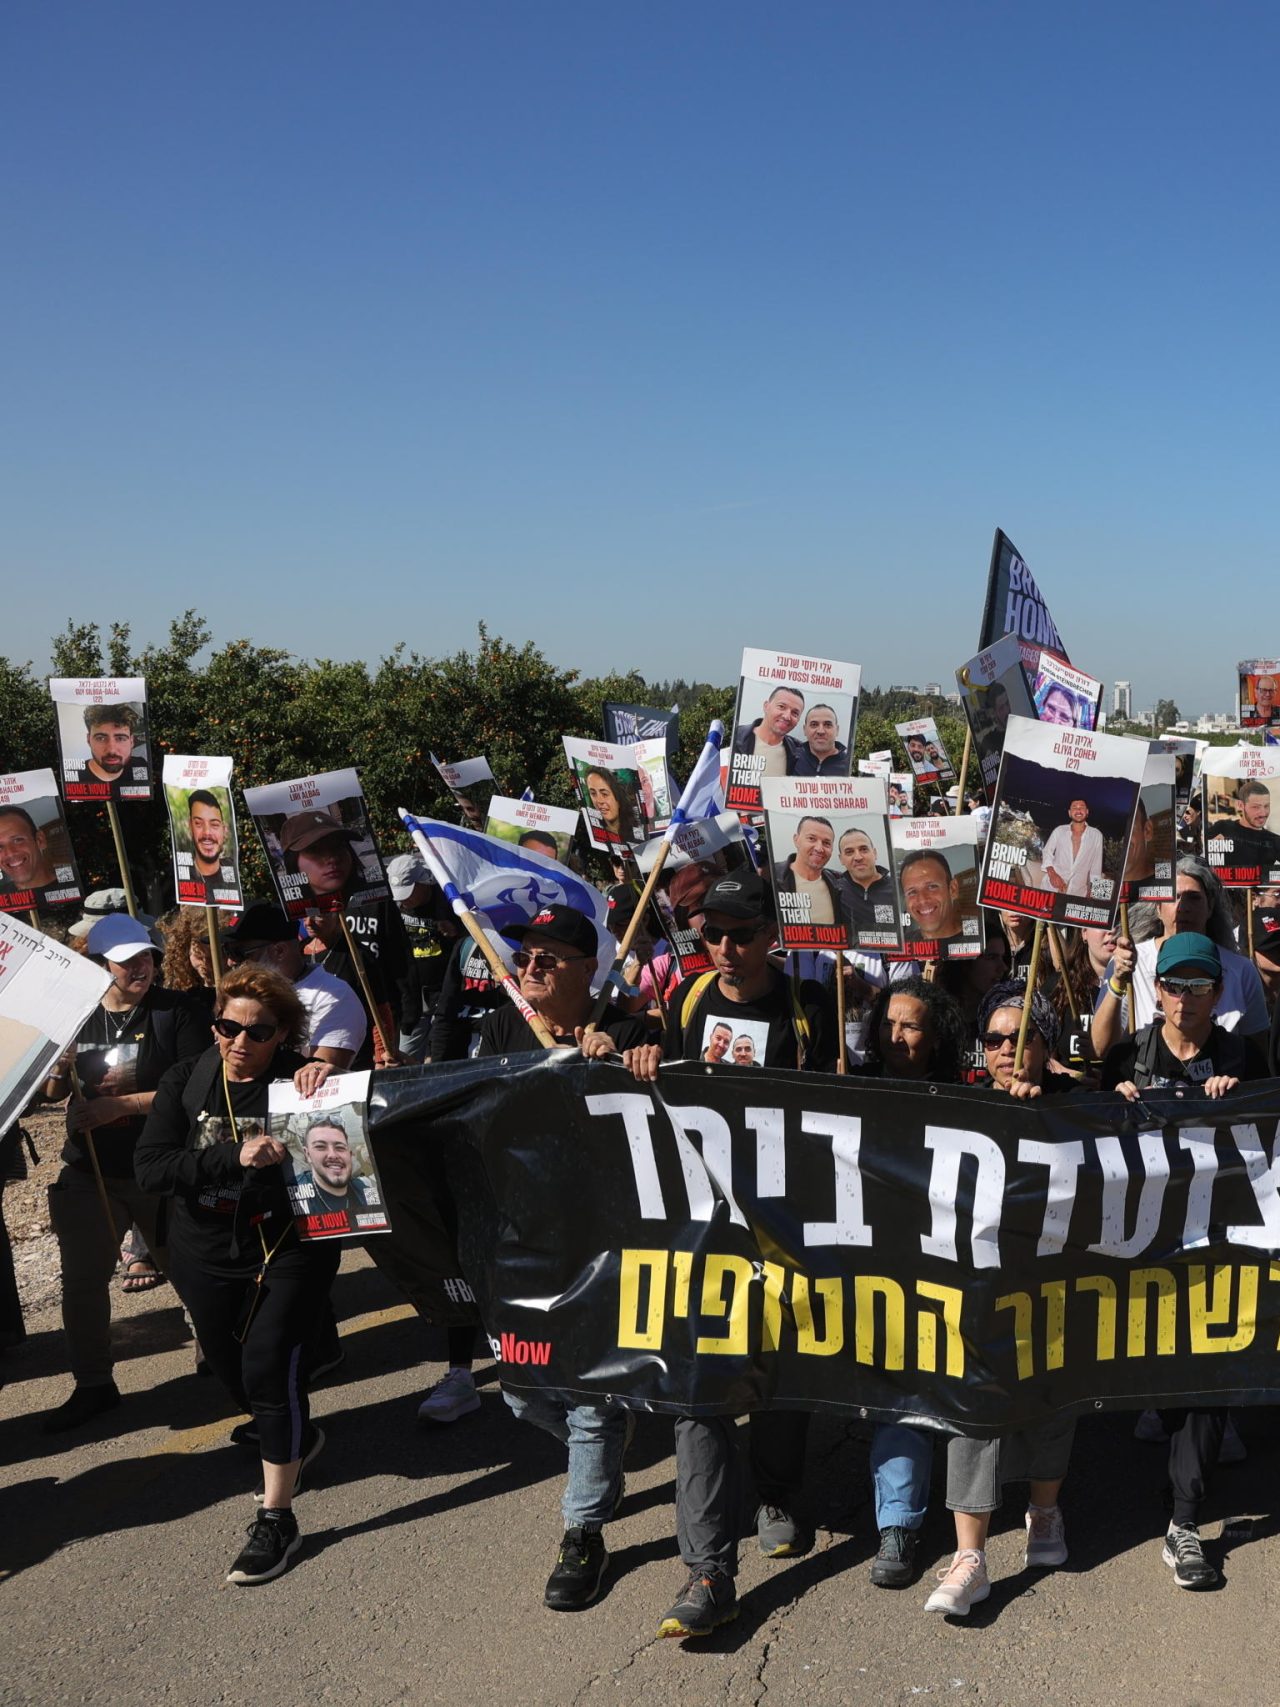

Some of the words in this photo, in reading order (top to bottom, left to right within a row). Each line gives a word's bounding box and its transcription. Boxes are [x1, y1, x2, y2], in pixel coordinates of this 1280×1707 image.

[777, 656, 800, 668] שרעבי
[1019, 646, 1040, 663] TAGES
[802, 660, 818, 671] ויוסי
[820, 662, 832, 673] אלי
[759, 667, 769, 677] ELI
[771, 669, 786, 680] AND
[788, 671, 808, 683] YOSSI
[811, 674, 843, 689] SHARABI
[1056, 674, 1093, 697] STEINBRECHER
[1062, 733, 1074, 744] כהן
[1075, 734, 1093, 746] אליה
[1054, 744, 1072, 757] ELIYA
[1074, 747, 1097, 761] COHEN
[64, 759, 85, 770] BRING
[733, 753, 766, 771] BRING
[1065, 759, 1080, 770] (27)
[65, 770, 79, 782] HIM
[732, 769, 760, 786] THEM
[66, 784, 88, 795] HOME
[89, 783, 111, 795] NOW!
[290, 792, 301, 801] LIRI
[301, 789, 320, 799] ALBAG
[795, 782, 819, 794] שרעבי
[820, 782, 836, 794] ויוסי
[837, 782, 853, 793] אלי
[729, 787, 760, 804] HOME
[781, 797, 792, 808] ELI
[793, 797, 808, 809] AND
[809, 798, 832, 809] YOSSI
[833, 798, 868, 809] SHARABI
[529, 812, 550, 822] WENKERT
[1208, 840, 1234, 852] BRING
[177, 851, 193, 866] BRING
[991, 842, 1028, 866] BRING
[1209, 853, 1224, 866] HIM
[178, 866, 190, 880] HIM
[988, 860, 1011, 881] HIM
[1234, 866, 1261, 881] NOW!
[278, 872, 308, 889] BRING
[283, 888, 303, 901] HER
[779, 891, 811, 908] BRING
[985, 880, 1018, 901] HOME
[1021, 889, 1056, 912] NOW!
[780, 908, 811, 924] THEM
[345, 915, 378, 935] OUR
[672, 928, 700, 943] BRING
[784, 926, 814, 942] HOME
[817, 926, 847, 942] NOW!
[859, 936, 879, 945] FAMILIES
[676, 941, 696, 954] HER
[913, 940, 939, 955] NOW!
[45, 949, 71, 969] חייב
[682, 954, 707, 971] HOME
[585, 1092, 873, 1248] ביחד
[288, 1183, 315, 1200] BRING
[291, 1201, 310, 1215] HIM
[307, 1214, 321, 1230] ME
[323, 1211, 349, 1228] NOW!
[617, 1248, 964, 1379] החטופים
